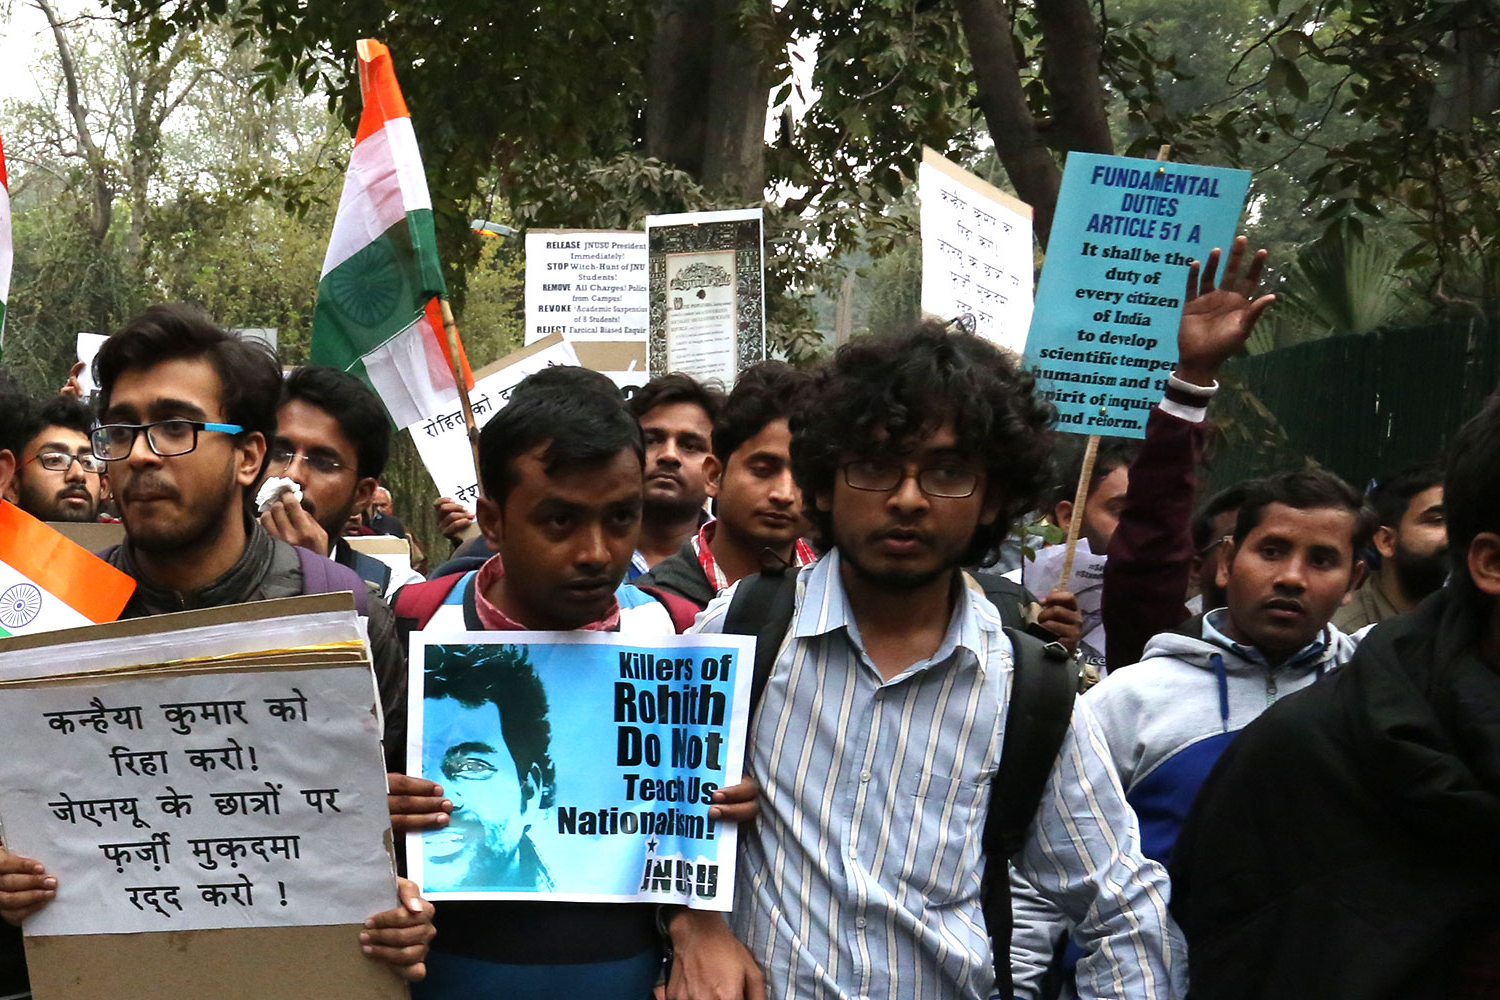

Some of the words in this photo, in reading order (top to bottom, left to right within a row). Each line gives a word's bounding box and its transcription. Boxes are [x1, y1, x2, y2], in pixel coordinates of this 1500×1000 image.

[1091, 165, 1220, 198] FUNDAMENTAL
[1120, 193, 1180, 217] DUTIES
[1085, 213, 1157, 239] ARTICLE
[1159, 221, 1182, 241] 51
[1186, 224, 1202, 244] A
[546, 241, 581, 249] RELEASE
[583, 242, 610, 250] JNUSU
[611, 242, 646, 250] President
[1080, 242, 1098, 257] It
[1101, 244, 1140, 262] shall
[1143, 247, 1161, 264] be
[1164, 250, 1194, 267] the
[547, 262, 569, 271] STOP
[570, 263, 619, 271] Witch-Hunt
[620, 263, 629, 271] of
[629, 263, 646, 272] JNU
[570, 252, 625, 261] Immediately!
[578, 273, 618, 281] Students!
[1105, 267, 1142, 285] duty
[1143, 271, 1162, 285] of
[542, 283, 571, 292] REMOVE
[575, 284, 588, 292] All
[589, 284, 627, 293] Charges!
[1075, 288, 1124, 305] every
[1126, 292, 1180, 308] citizen
[538, 305, 572, 313] REVOKE
[591, 295, 623, 303] Campus!
[1093, 310, 1112, 323] of
[1114, 311, 1151, 327] India
[1077, 329, 1096, 343] to
[1099, 331, 1158, 350] develop
[1039, 347, 1118, 367] scientific
[1119, 376, 1151, 390] and
[1090, 393, 1107, 406] of
[423, 410, 466, 438] रोहित
[1087, 412, 1143, 430] reform.
[619, 651, 693, 681] Killers
[700, 653, 733, 682] of
[43, 696, 144, 735] कन्हैया
[160, 698, 248, 735] कुमार
[264, 688, 309, 722] को
[614, 681, 727, 727] Rohith
[110, 745, 168, 777] रिहा
[185, 737, 260, 773] करो!
[616, 725, 662, 767] Do
[671, 727, 723, 771] Not
[623, 774, 685, 802] Teach
[687, 776, 719, 806] Us
[47, 792, 152, 829] जेएनयू
[156, 786, 194, 819] के
[209, 782, 283, 817] छात्रों
[300, 788, 342, 814] पर
[557, 806, 716, 841] Nationalism!
[197, 873, 253, 907] करो
